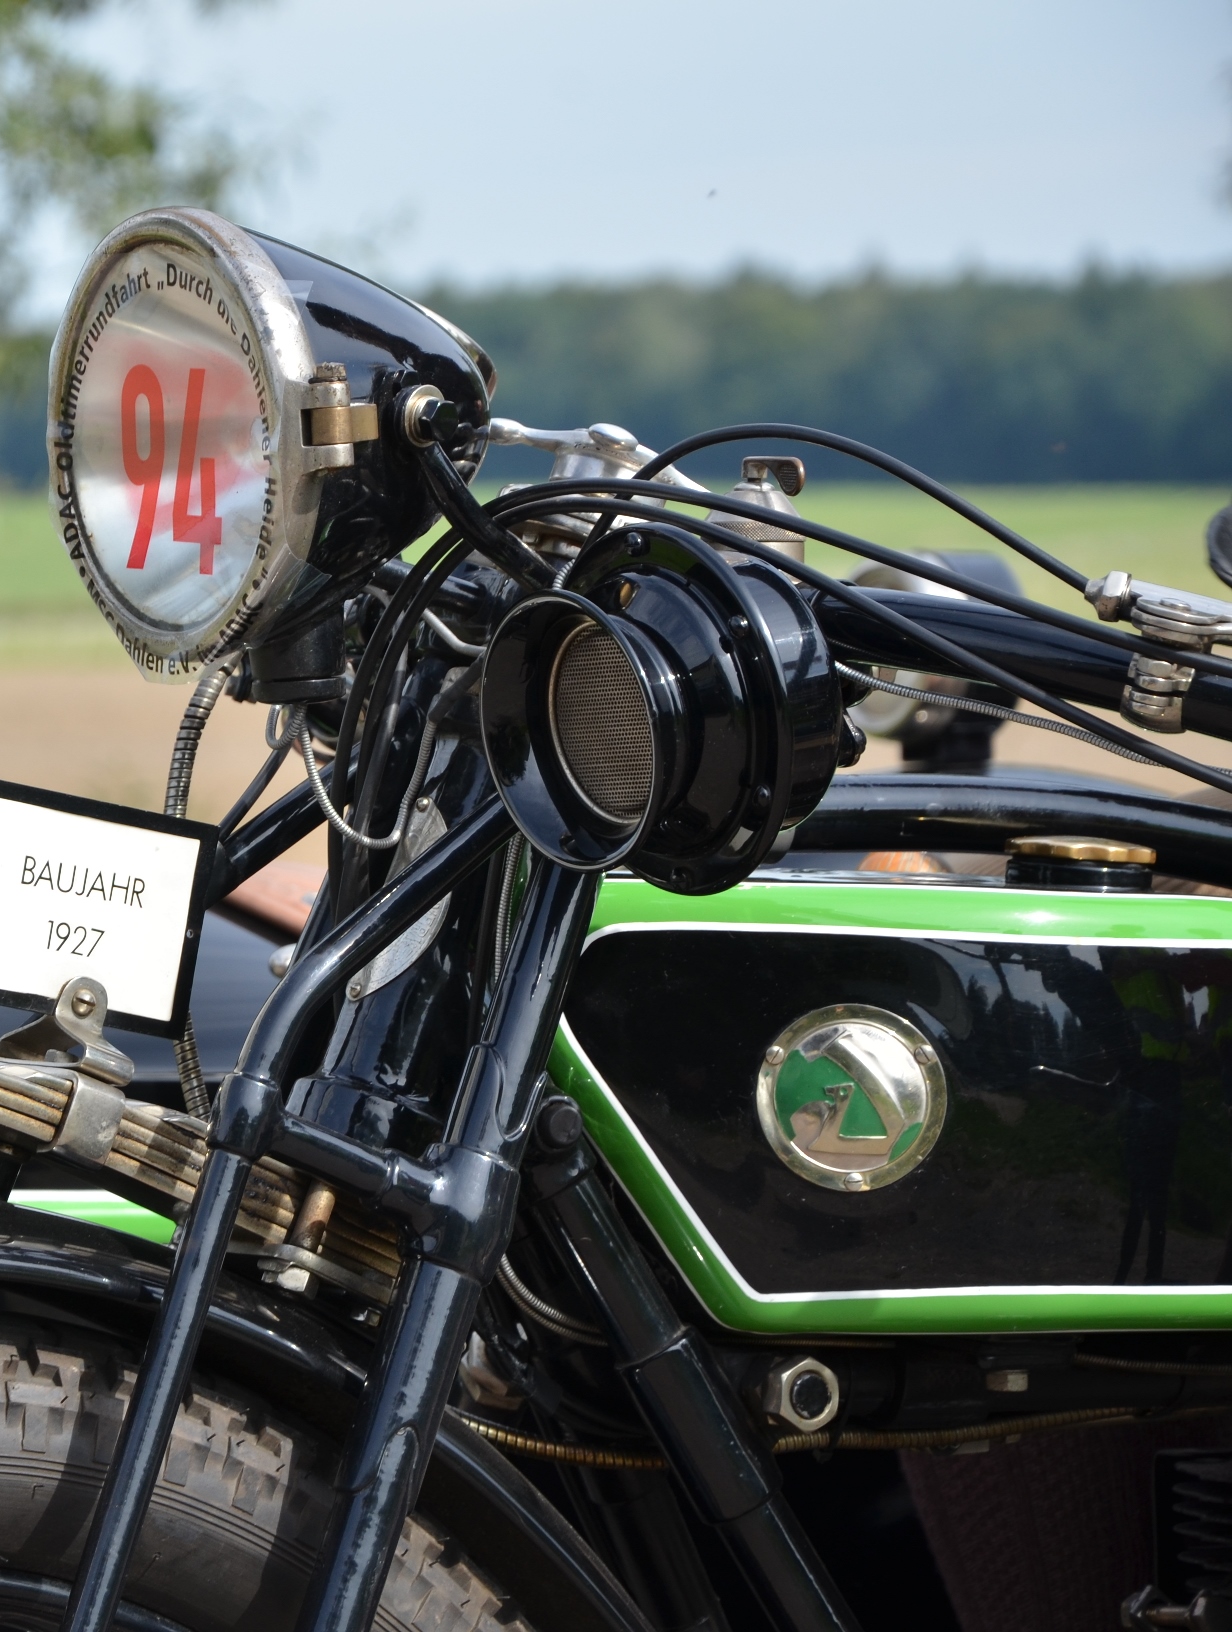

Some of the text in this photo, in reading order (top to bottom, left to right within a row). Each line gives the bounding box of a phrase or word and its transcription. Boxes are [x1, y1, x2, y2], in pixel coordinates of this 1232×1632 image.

[53, 267, 151, 471] Oldtimerrundfahrt
[240, 331, 274, 464] Dahlener
[121, 363, 223, 576] 94
[58, 484, 85, 561] ADAC
[115, 622, 164, 674] Dahlen
[20, 855, 146, 909] BAUJAHR
[46, 919, 106, 958] 1927
